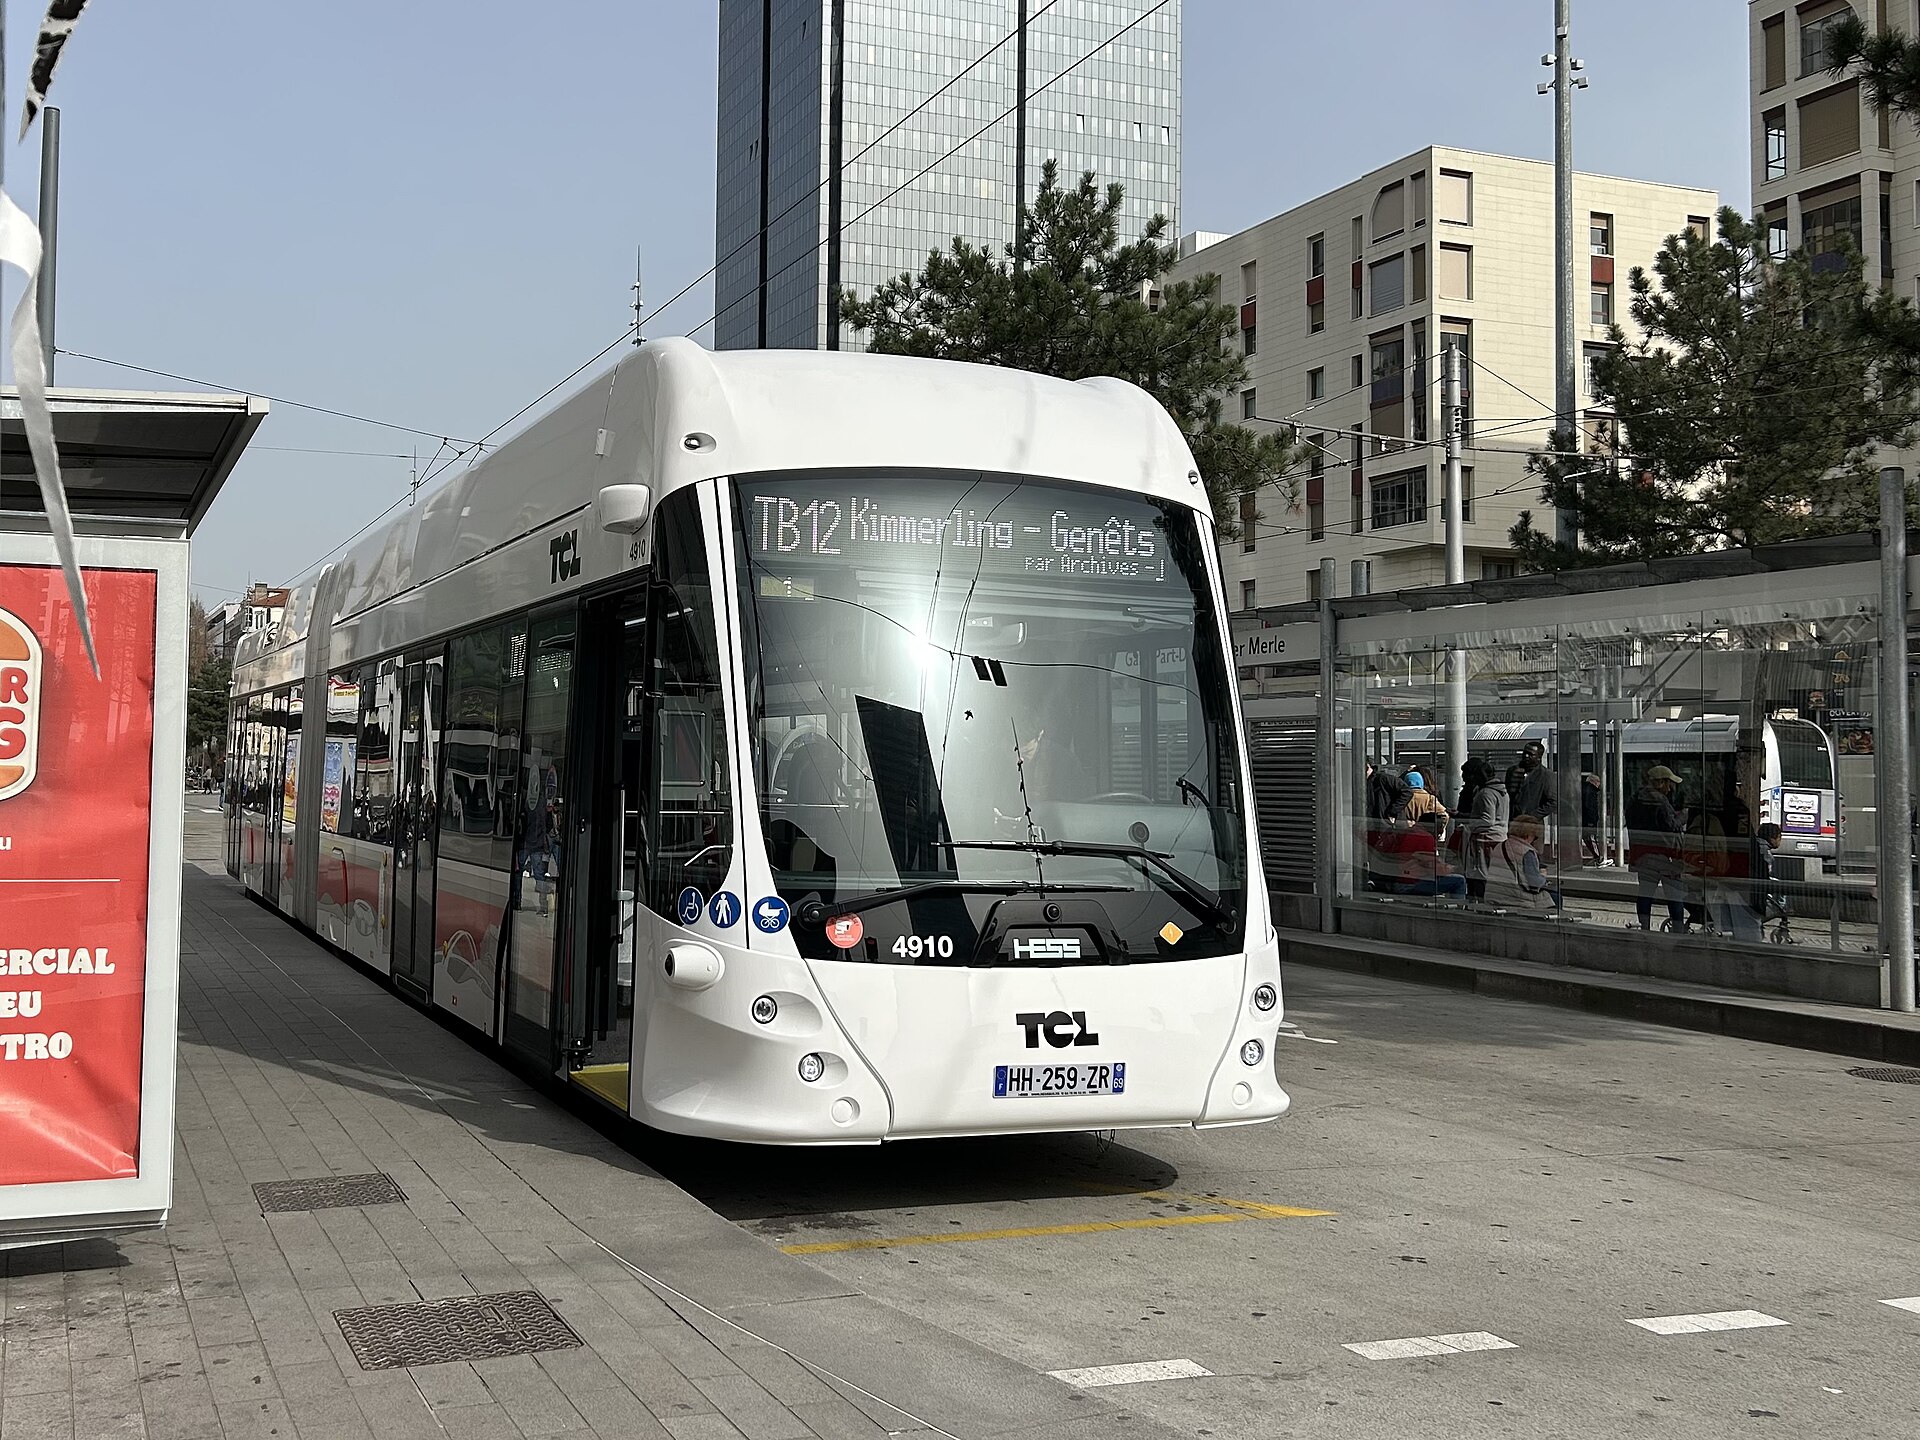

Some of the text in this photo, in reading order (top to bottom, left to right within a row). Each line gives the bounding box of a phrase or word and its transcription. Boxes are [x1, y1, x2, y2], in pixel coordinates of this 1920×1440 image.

[754, 495, 842, 554] TB12
[850, 497, 1013, 549] Kimmerling
[1051, 510, 1155, 557] Genêts
[550, 528, 581, 584] TCL
[629, 538, 646, 561] 4910
[1024, 556, 1054, 572] par
[1060, 554, 1139, 576] Archives
[1248, 635, 1285, 655] Merle
[891, 935, 954, 958] 4910
[1013, 939, 1081, 959] HESS
[1016, 1011, 1099, 1049] TCL
[0, 1031, 73, 1061] TRO
[998, 1066, 1124, 1092] F HH-259-ZR 69
